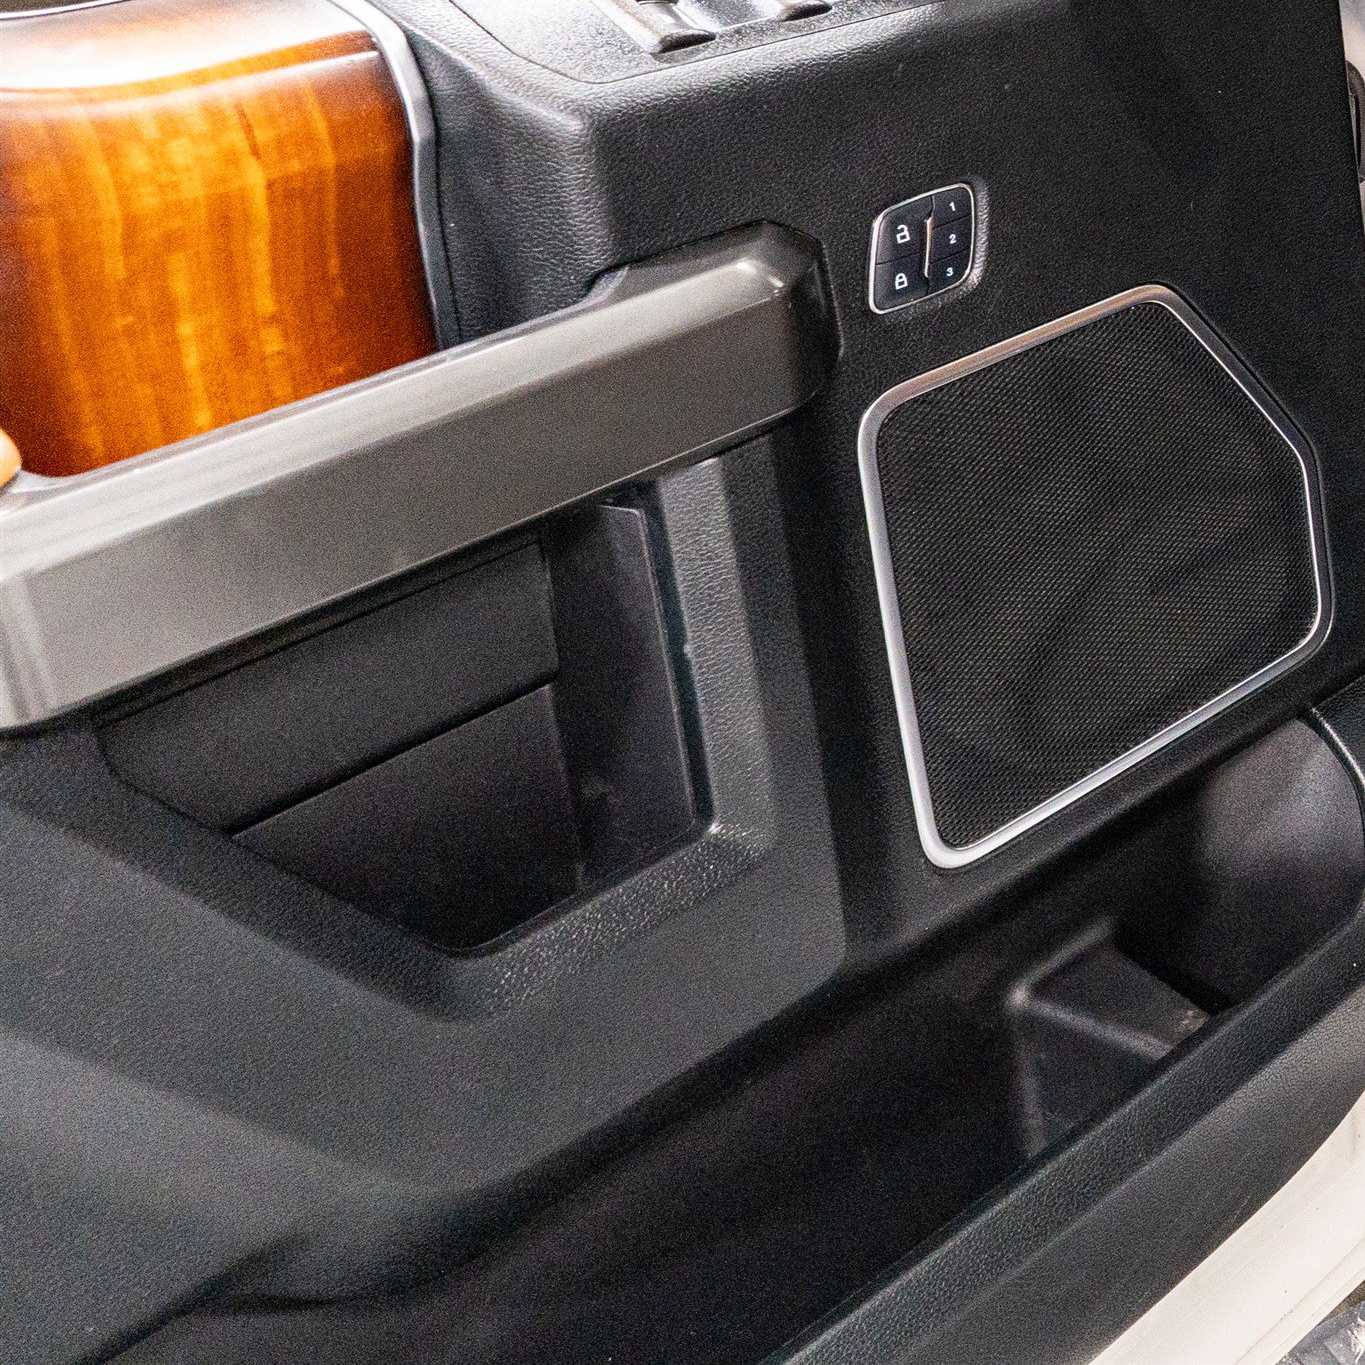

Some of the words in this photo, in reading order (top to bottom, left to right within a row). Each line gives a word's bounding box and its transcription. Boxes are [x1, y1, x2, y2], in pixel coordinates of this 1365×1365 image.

[949, 202, 956, 212] 1
[949, 234, 957, 244] 2
[946, 267, 954, 277] 3
